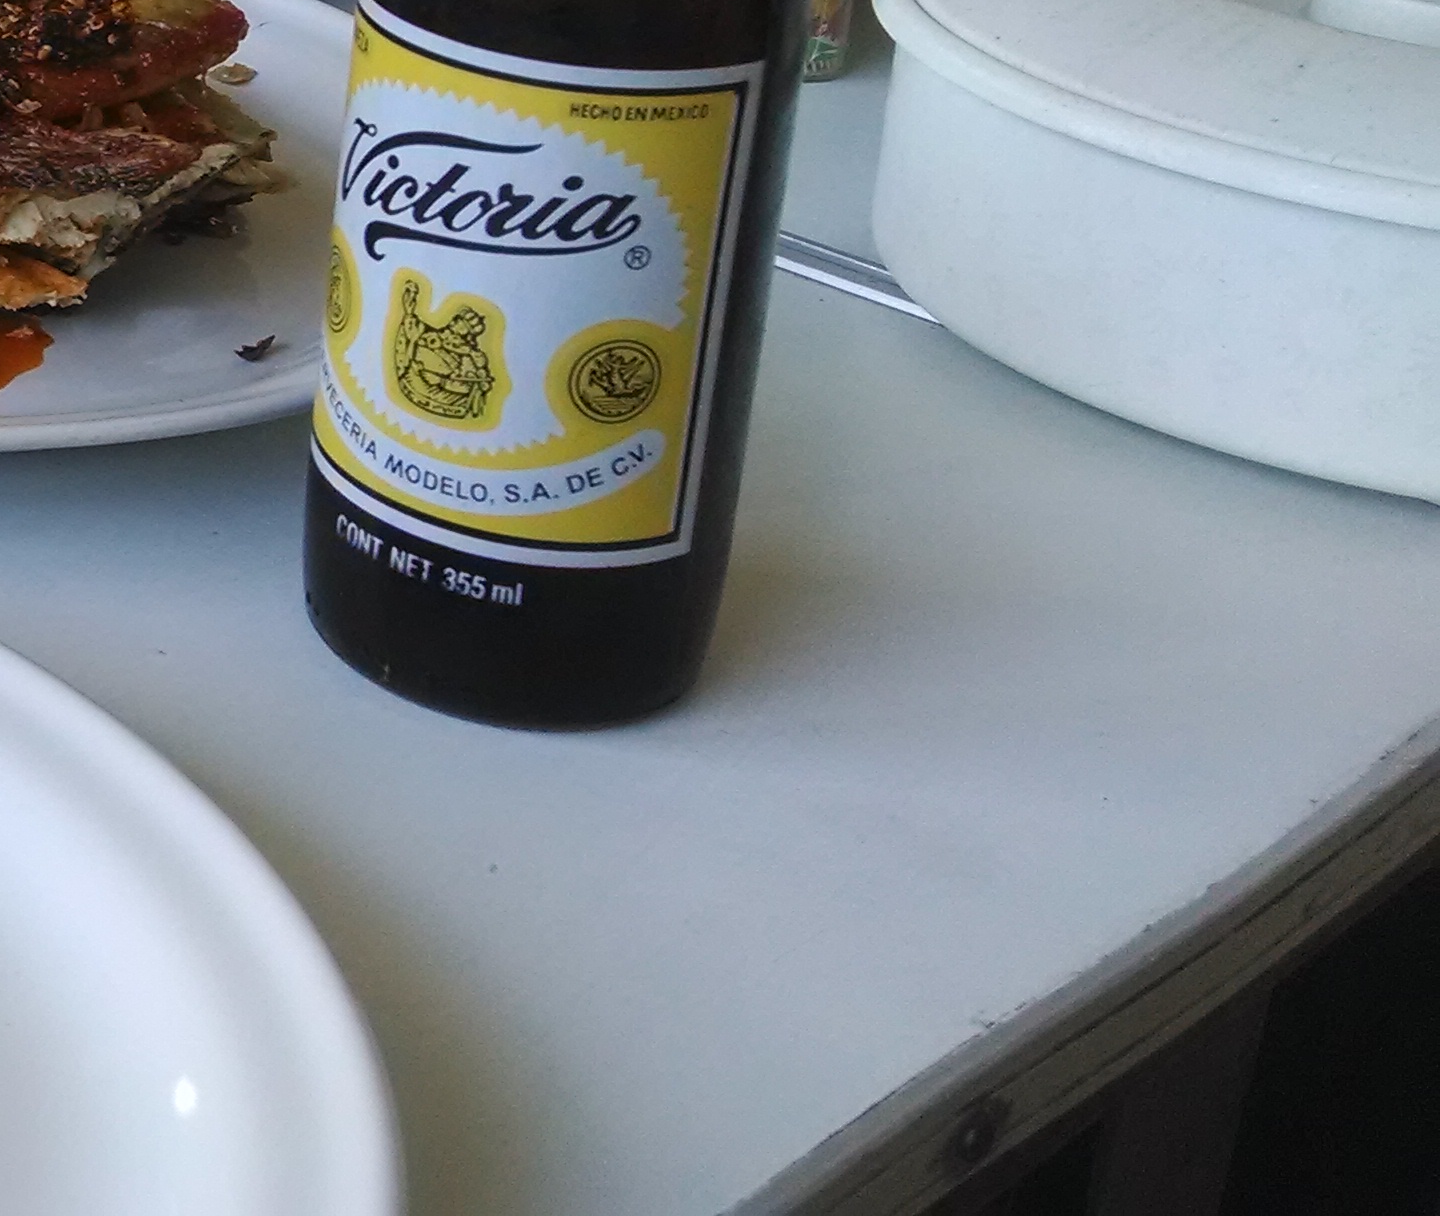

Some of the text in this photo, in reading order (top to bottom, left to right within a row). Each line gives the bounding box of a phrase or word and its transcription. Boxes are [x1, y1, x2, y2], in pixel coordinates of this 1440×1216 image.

[570, 103, 710, 121] HECHO EN MEXICO
[342, 118, 642, 261] Victoria
[504, 483, 561, 504] S.A.
[565, 472, 606, 495] DE
[611, 443, 654, 478] C.V.
[335, 514, 524, 607] CONT NET 355 ml
